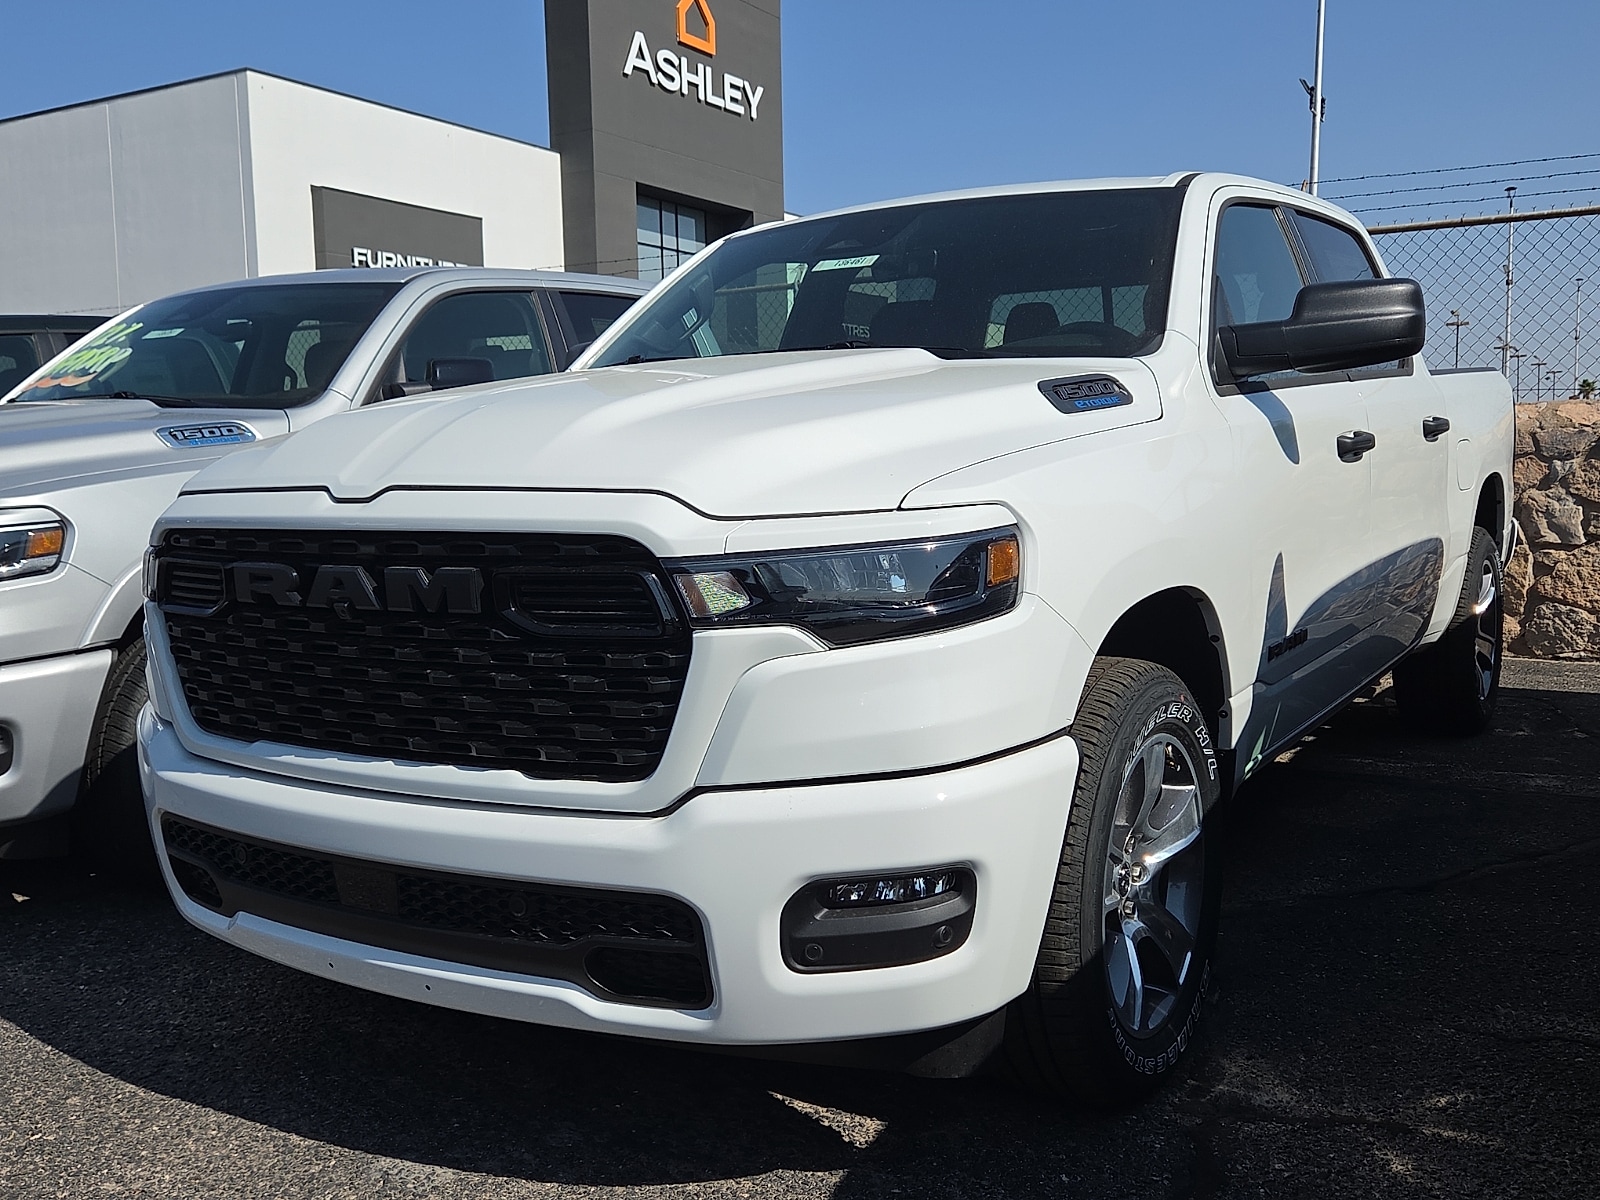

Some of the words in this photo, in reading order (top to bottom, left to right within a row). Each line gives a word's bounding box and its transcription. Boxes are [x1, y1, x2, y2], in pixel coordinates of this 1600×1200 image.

[623, 30, 765, 121] ASHLEY
[352, 246, 469, 268] FURNIT
[1052, 378, 1117, 401] 1500
[170, 425, 240, 441] 1500
[233, 561, 484, 614] RAM
